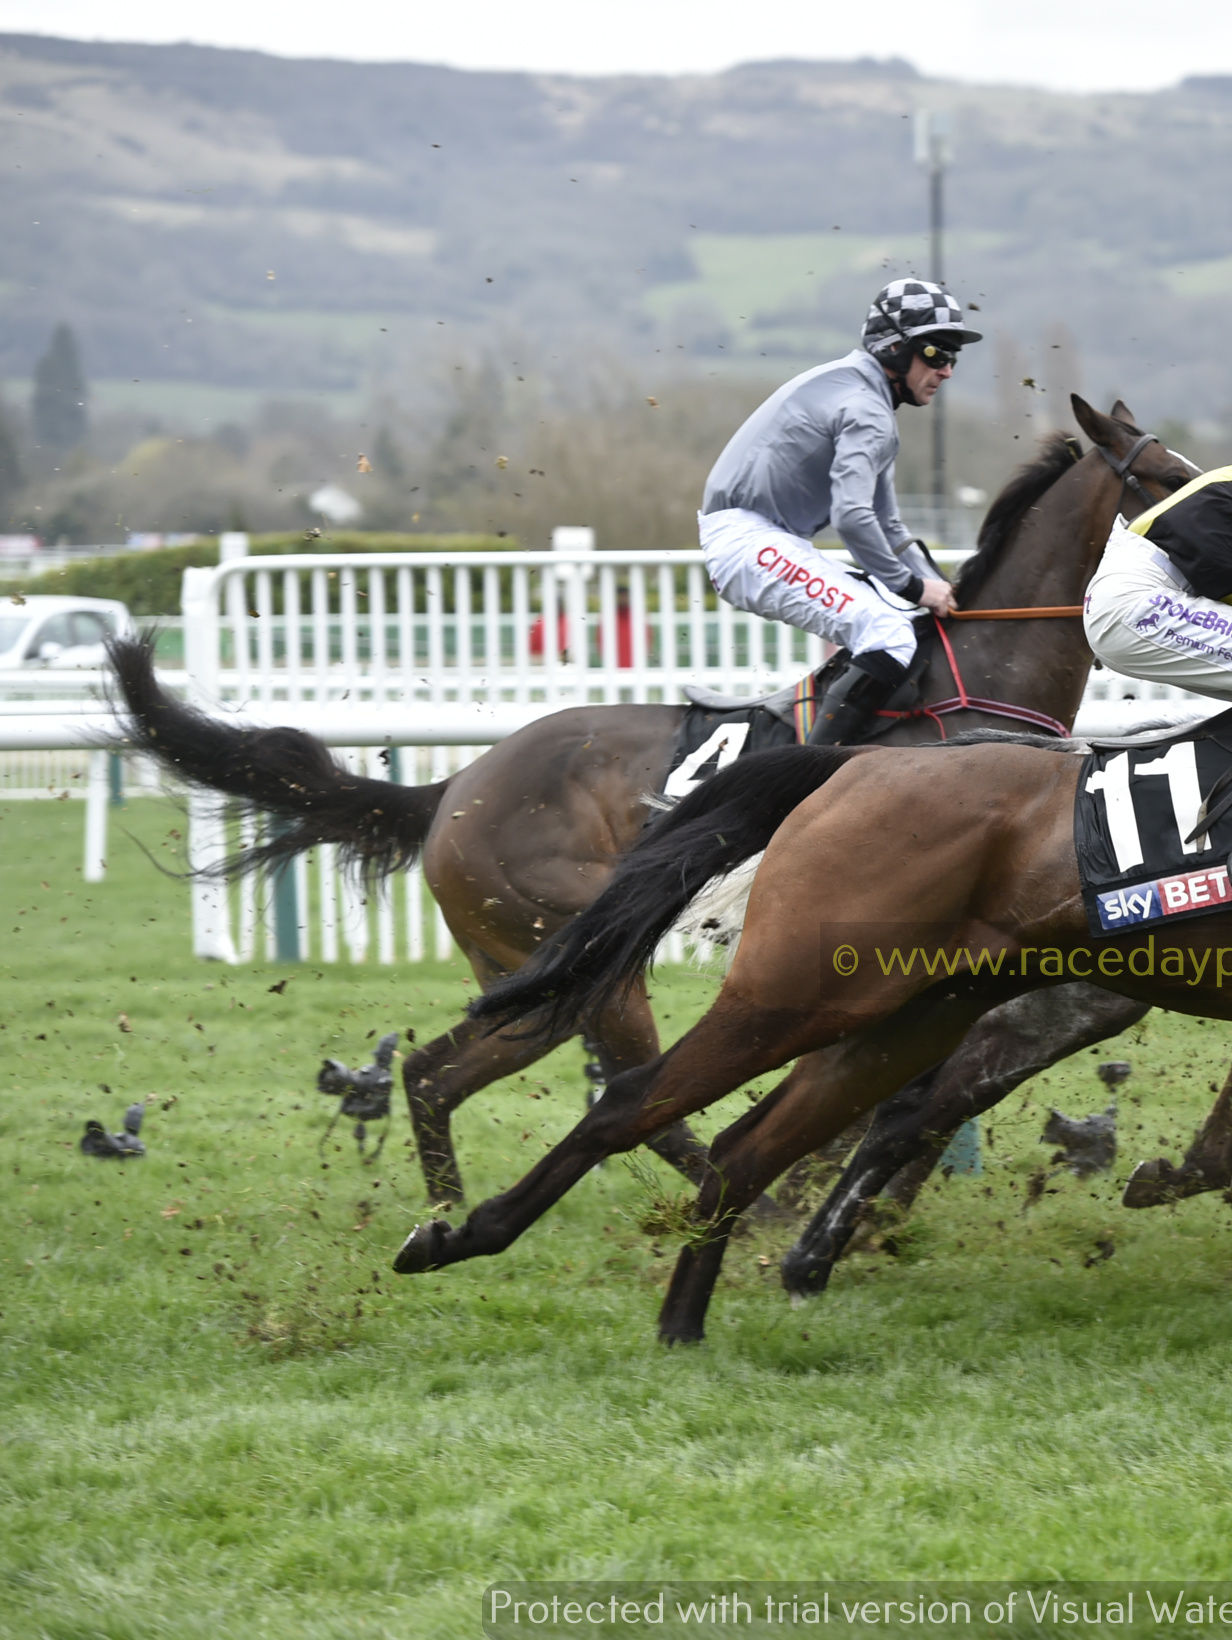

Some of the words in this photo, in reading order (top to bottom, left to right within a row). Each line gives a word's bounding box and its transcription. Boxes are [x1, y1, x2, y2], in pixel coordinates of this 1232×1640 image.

[757, 547, 854, 613] CITIPOST
[1165, 629, 1215, 655] Premium
[1085, 741, 1212, 873] 11
[1104, 889, 1153, 921] sky
[1163, 870, 1228, 908] BET
